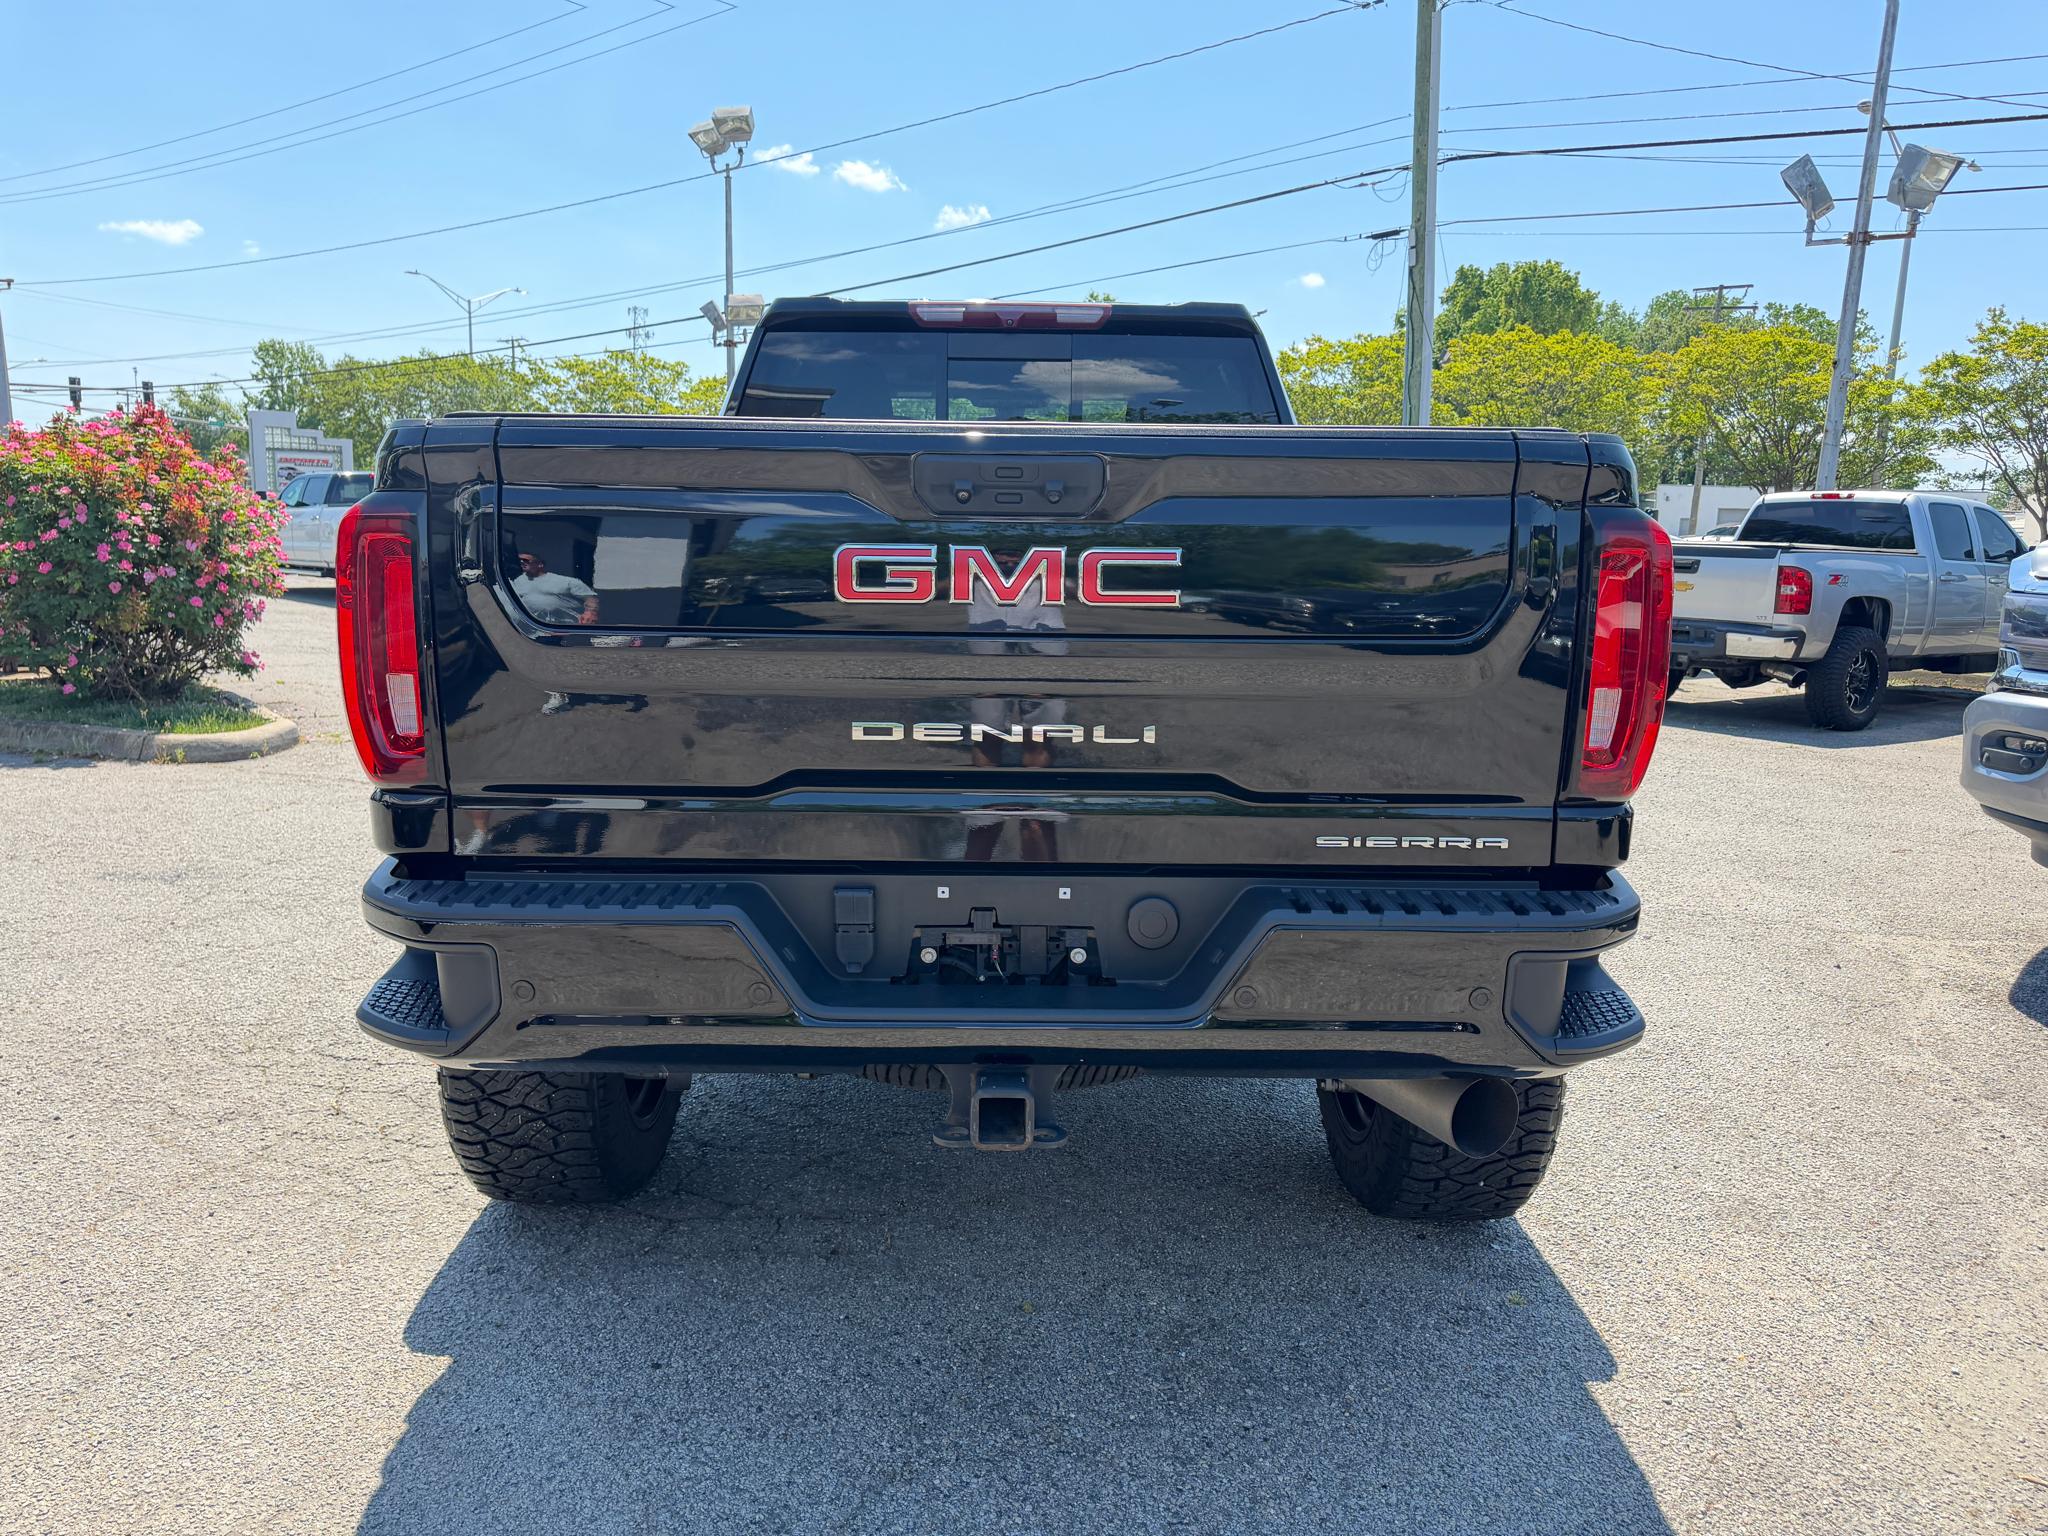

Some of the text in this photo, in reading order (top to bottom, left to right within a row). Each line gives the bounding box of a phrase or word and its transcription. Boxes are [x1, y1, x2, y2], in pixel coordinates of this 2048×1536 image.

[833, 543, 1182, 608] GMC
[852, 721, 1156, 744] DENALI
[1315, 836, 1509, 849] SIERRA
